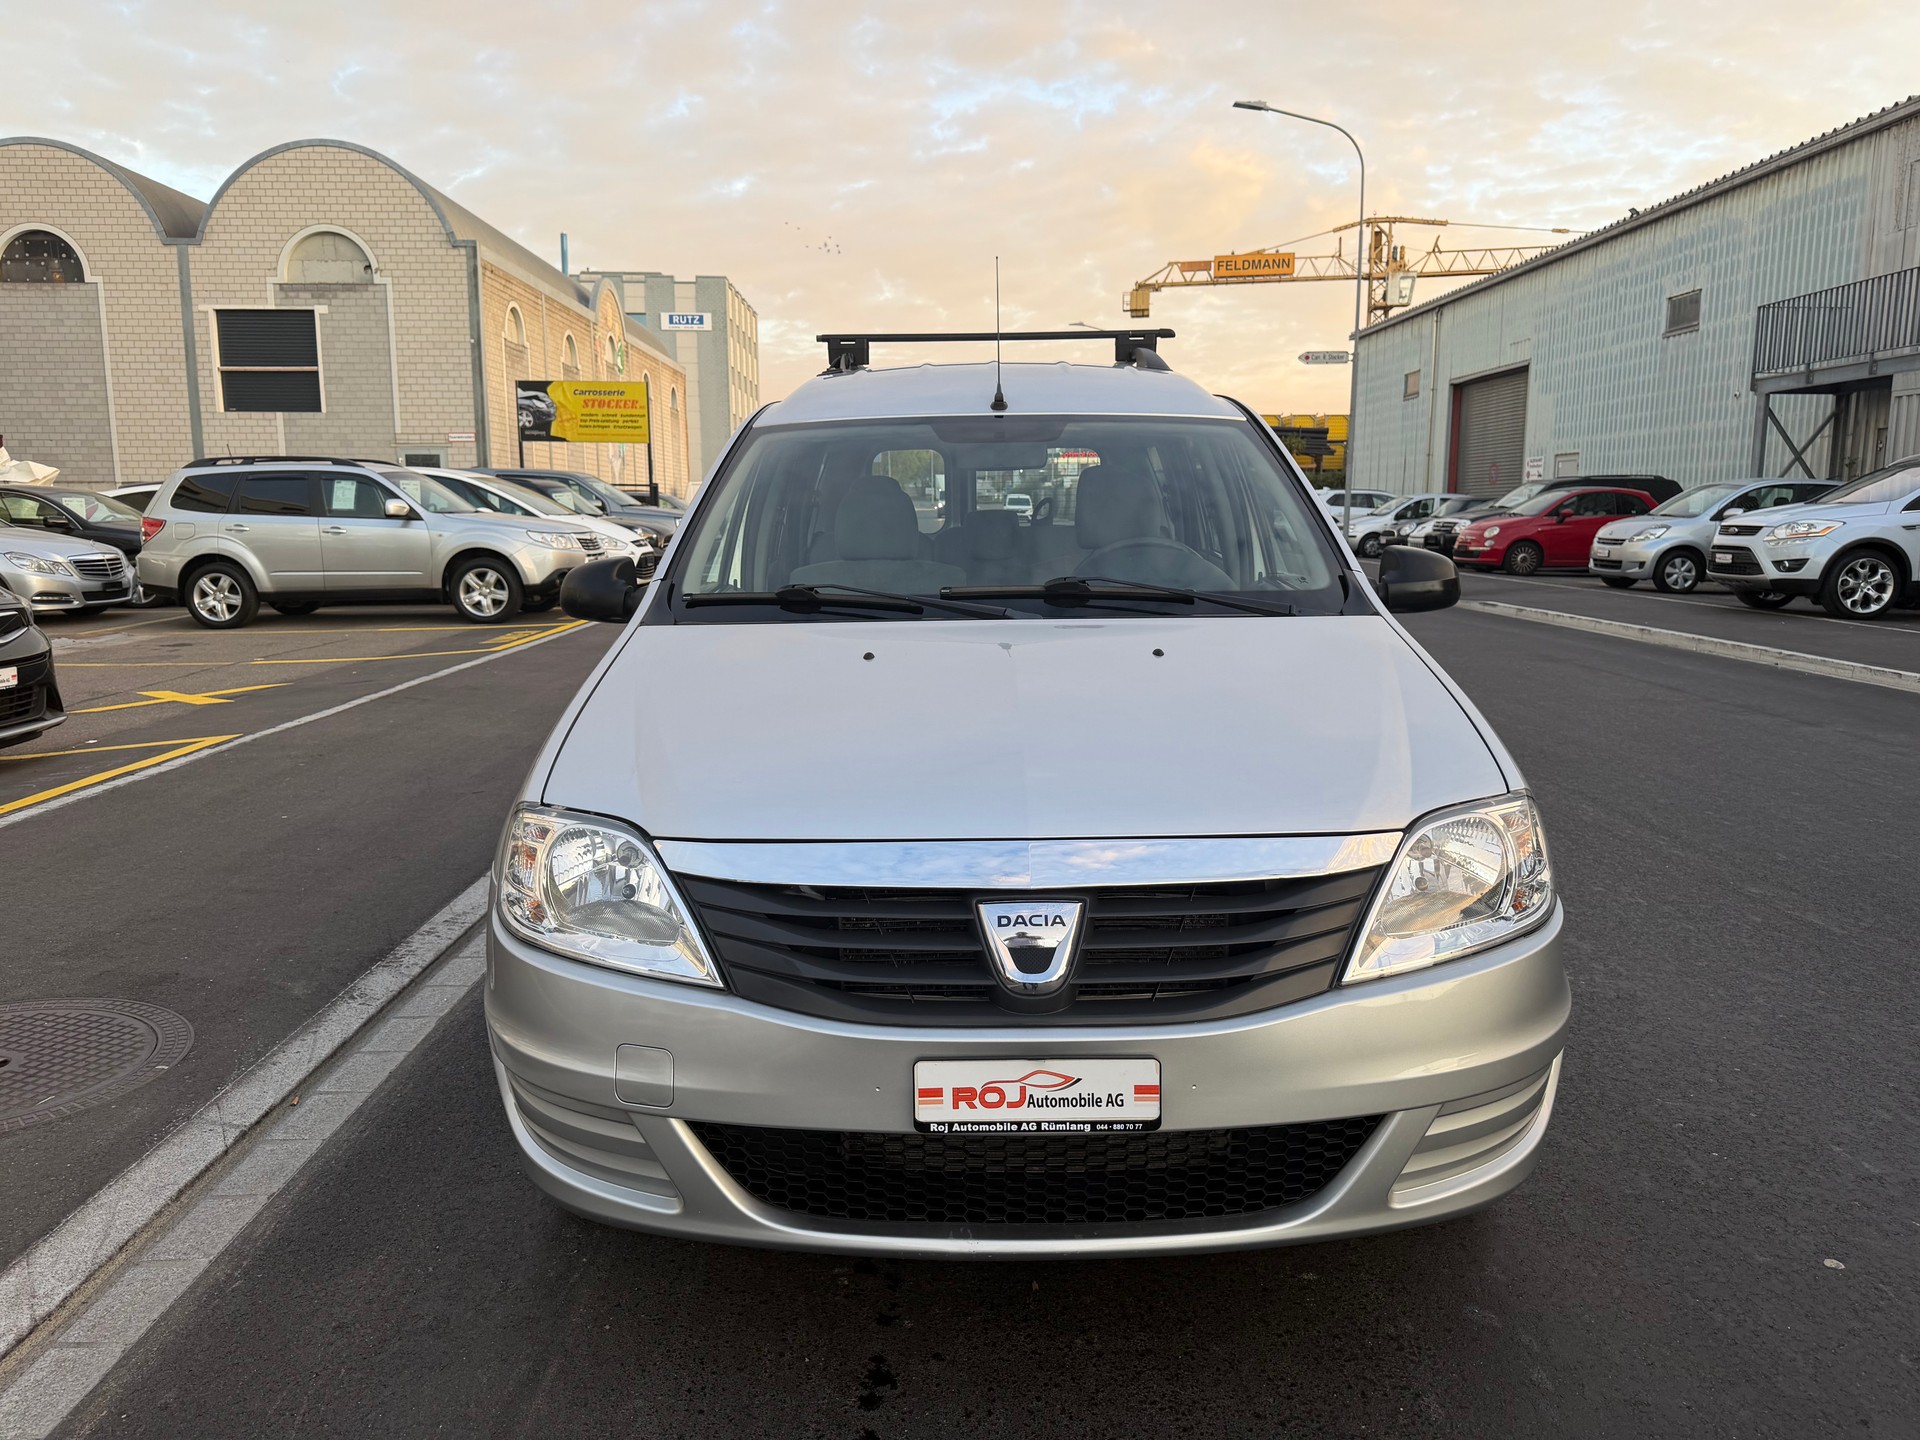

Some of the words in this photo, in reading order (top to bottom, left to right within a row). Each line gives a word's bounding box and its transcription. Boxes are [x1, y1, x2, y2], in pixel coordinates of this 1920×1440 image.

[1217, 257, 1291, 272] FELDMANN
[672, 315, 700, 324] RUTZ
[573, 388, 626, 397] Carrosserie
[582, 398, 639, 410] STOCKER
[997, 914, 1067, 928] DACIA
[952, 1085, 1027, 1110] ROJ
[1027, 1092, 1102, 1109] Automobile
[1105, 1093, 1125, 1108] AG
[930, 1123, 949, 1134] Roj
[952, 1122, 1018, 1132] Automobile
[1020, 1122, 1038, 1131] AG
[1041, 1122, 1091, 1132] Rümlang
